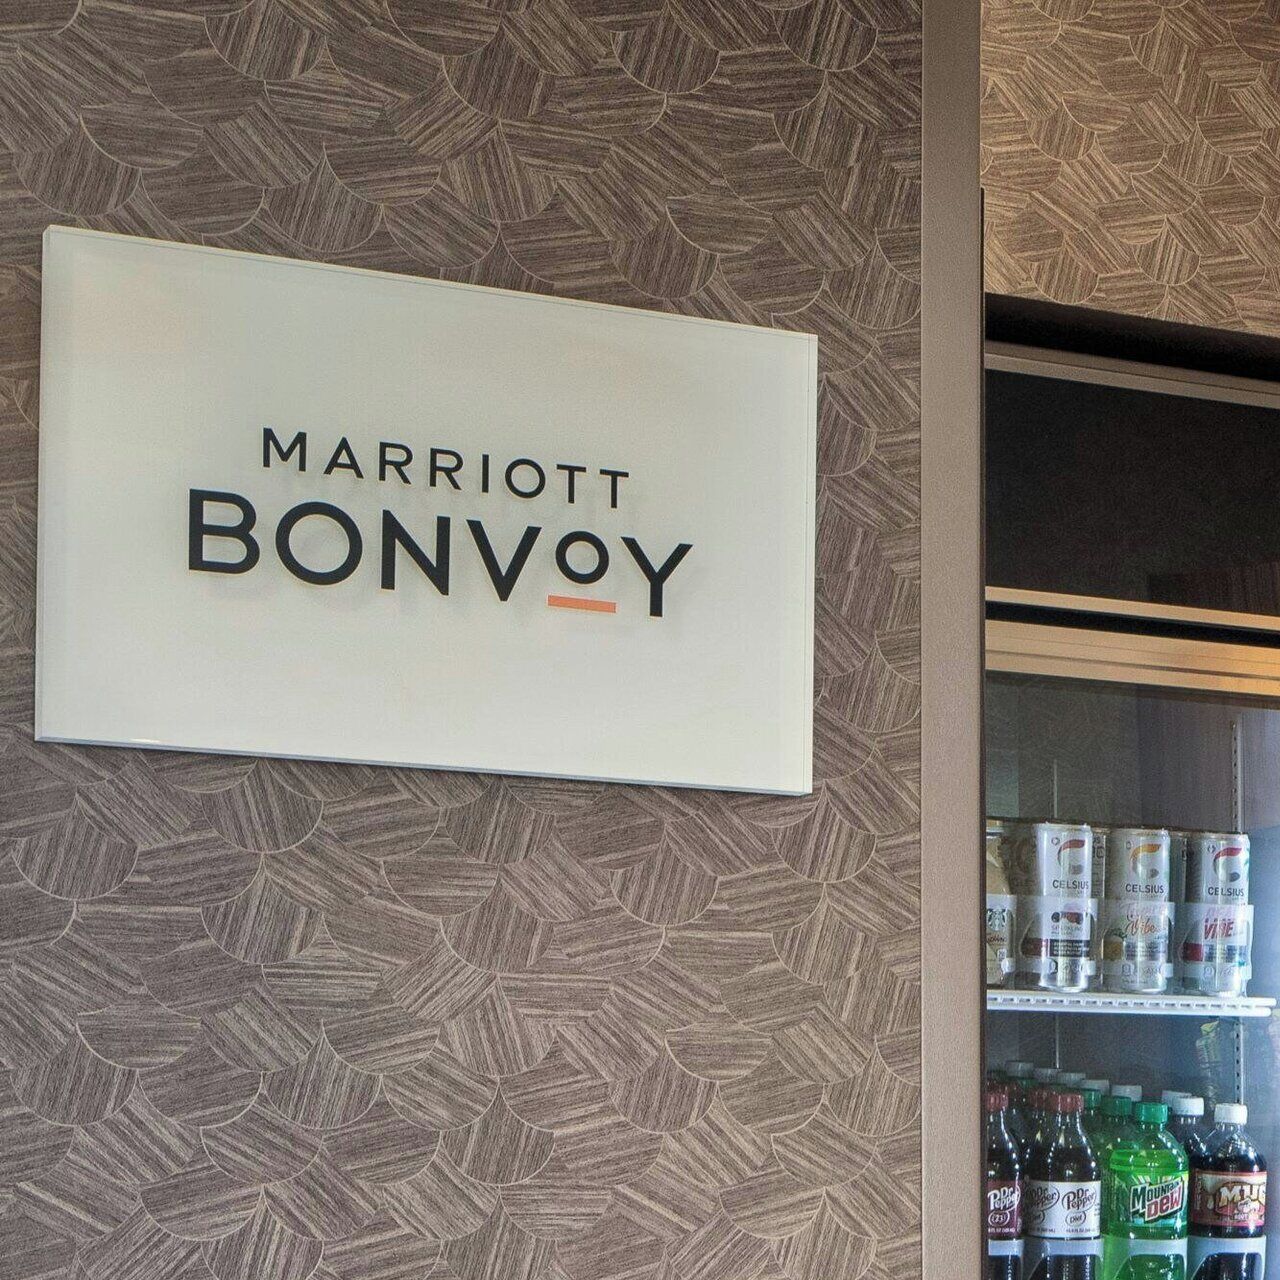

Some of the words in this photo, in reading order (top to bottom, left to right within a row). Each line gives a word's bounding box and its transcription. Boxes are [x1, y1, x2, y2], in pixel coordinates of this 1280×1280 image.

[262, 427, 630, 509] MARRIOTT
[188, 488, 694, 618] BONVOY
[1052, 880, 1089, 890] CELSIUS
[1125, 884, 1164, 894] CELSIUS
[1207, 886, 1245, 897] CELSIUS
